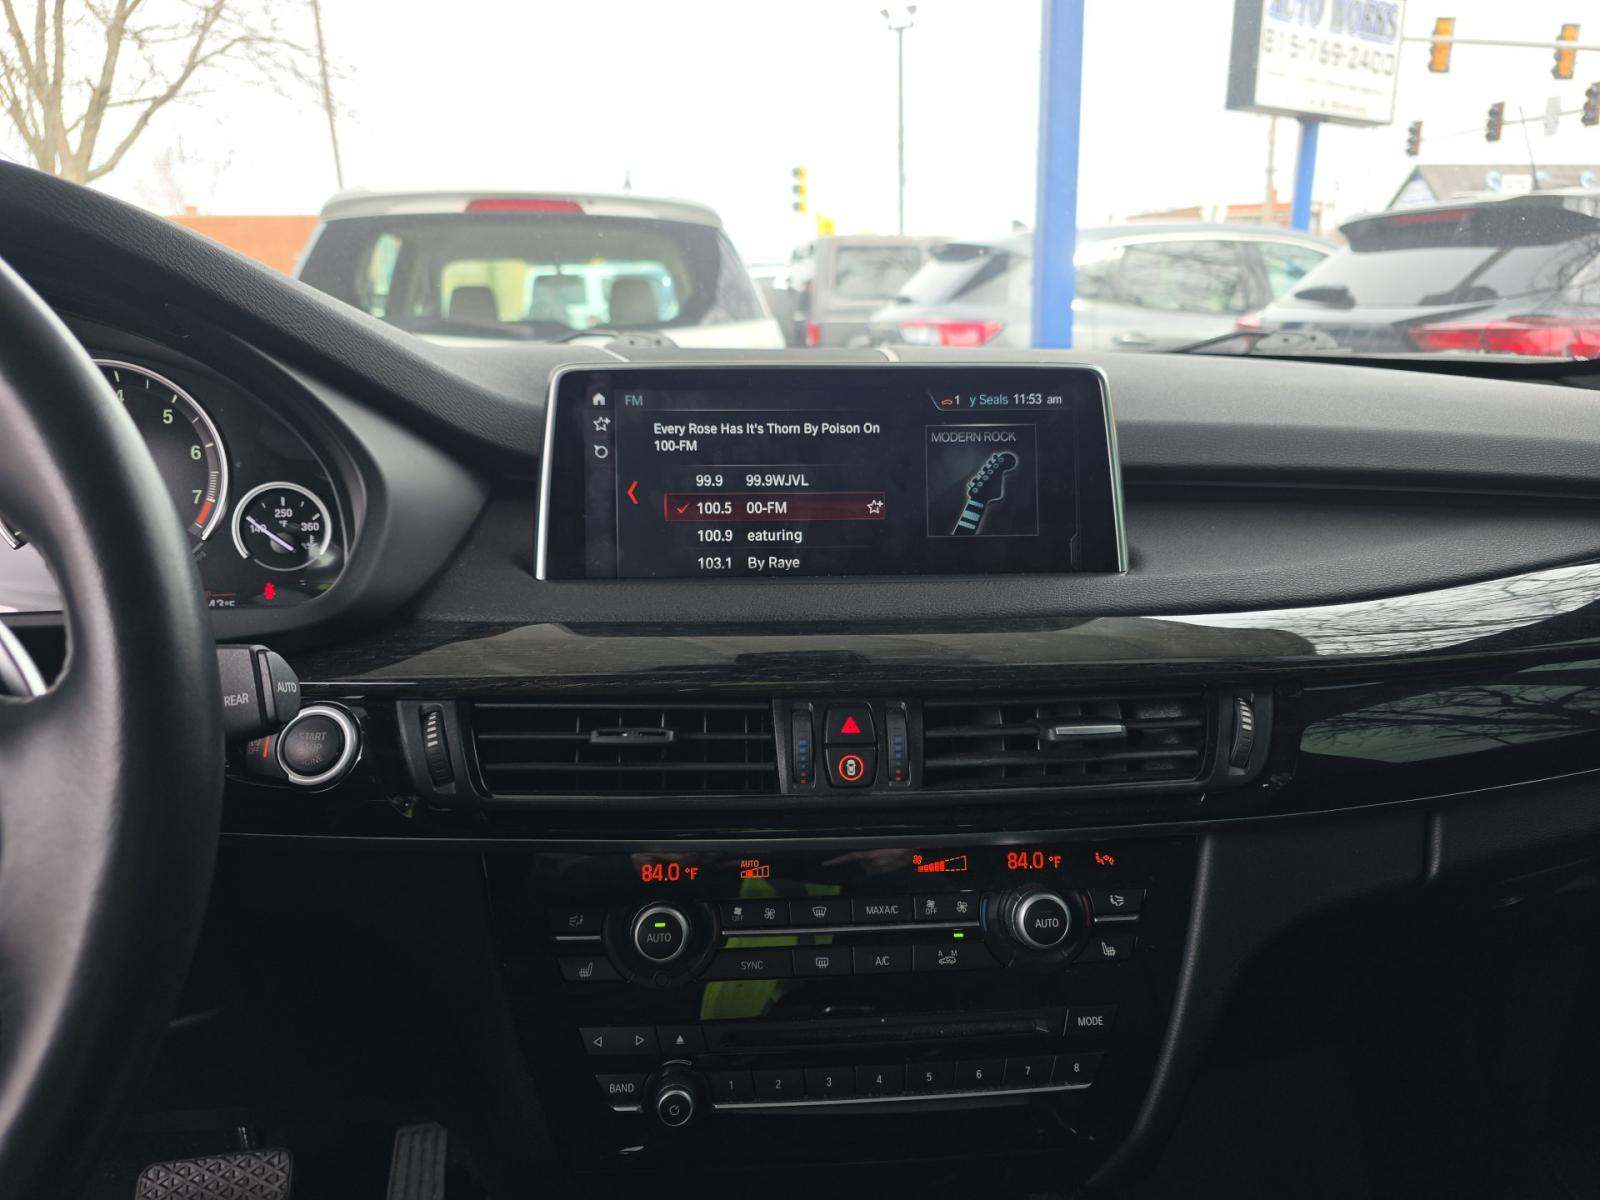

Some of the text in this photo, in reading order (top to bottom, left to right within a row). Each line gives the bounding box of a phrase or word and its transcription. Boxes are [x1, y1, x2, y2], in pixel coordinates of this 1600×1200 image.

[624, 394, 643, 406] FM
[979, 393, 1009, 406] Seals
[1013, 393, 1042, 405] 11:53
[1046, 396, 1062, 405] am
[163, 409, 174, 424] 5
[653, 422, 880, 437] Every Rose Has It's Thorn By Poison On
[931, 430, 1017, 443] MODERN ROCK
[653, 439, 698, 452] 100-FM
[190, 445, 202, 460] 6
[695, 473, 809, 487] 99.9 99.9WJVL
[192, 490, 202, 504] 7
[274, 508, 293, 519] 250
[696, 501, 788, 515] 100.5 00-FM
[301, 522, 320, 533] 360
[697, 528, 803, 543] 100.9 eaturing
[697, 555, 800, 571] 103.1 By Raye
[277, 681, 297, 694] AUTO
[224, 693, 249, 707] REAR
[740, 859, 759, 869] AUTO
[1007, 851, 1044, 870] 84.0
[641, 863, 680, 882] 84.0
[925, 907, 937, 915] OFF
[1035, 918, 1059, 928] AUTO
[646, 931, 672, 943] AUTO
[740, 960, 764, 971] SYNC
[875, 955, 890, 966] A/C
[1077, 1015, 1104, 1027] MODE
[728, 1062, 1080, 1090] 1 2 3 4 5 6 7 8
[608, 1082, 635, 1094] BAND
